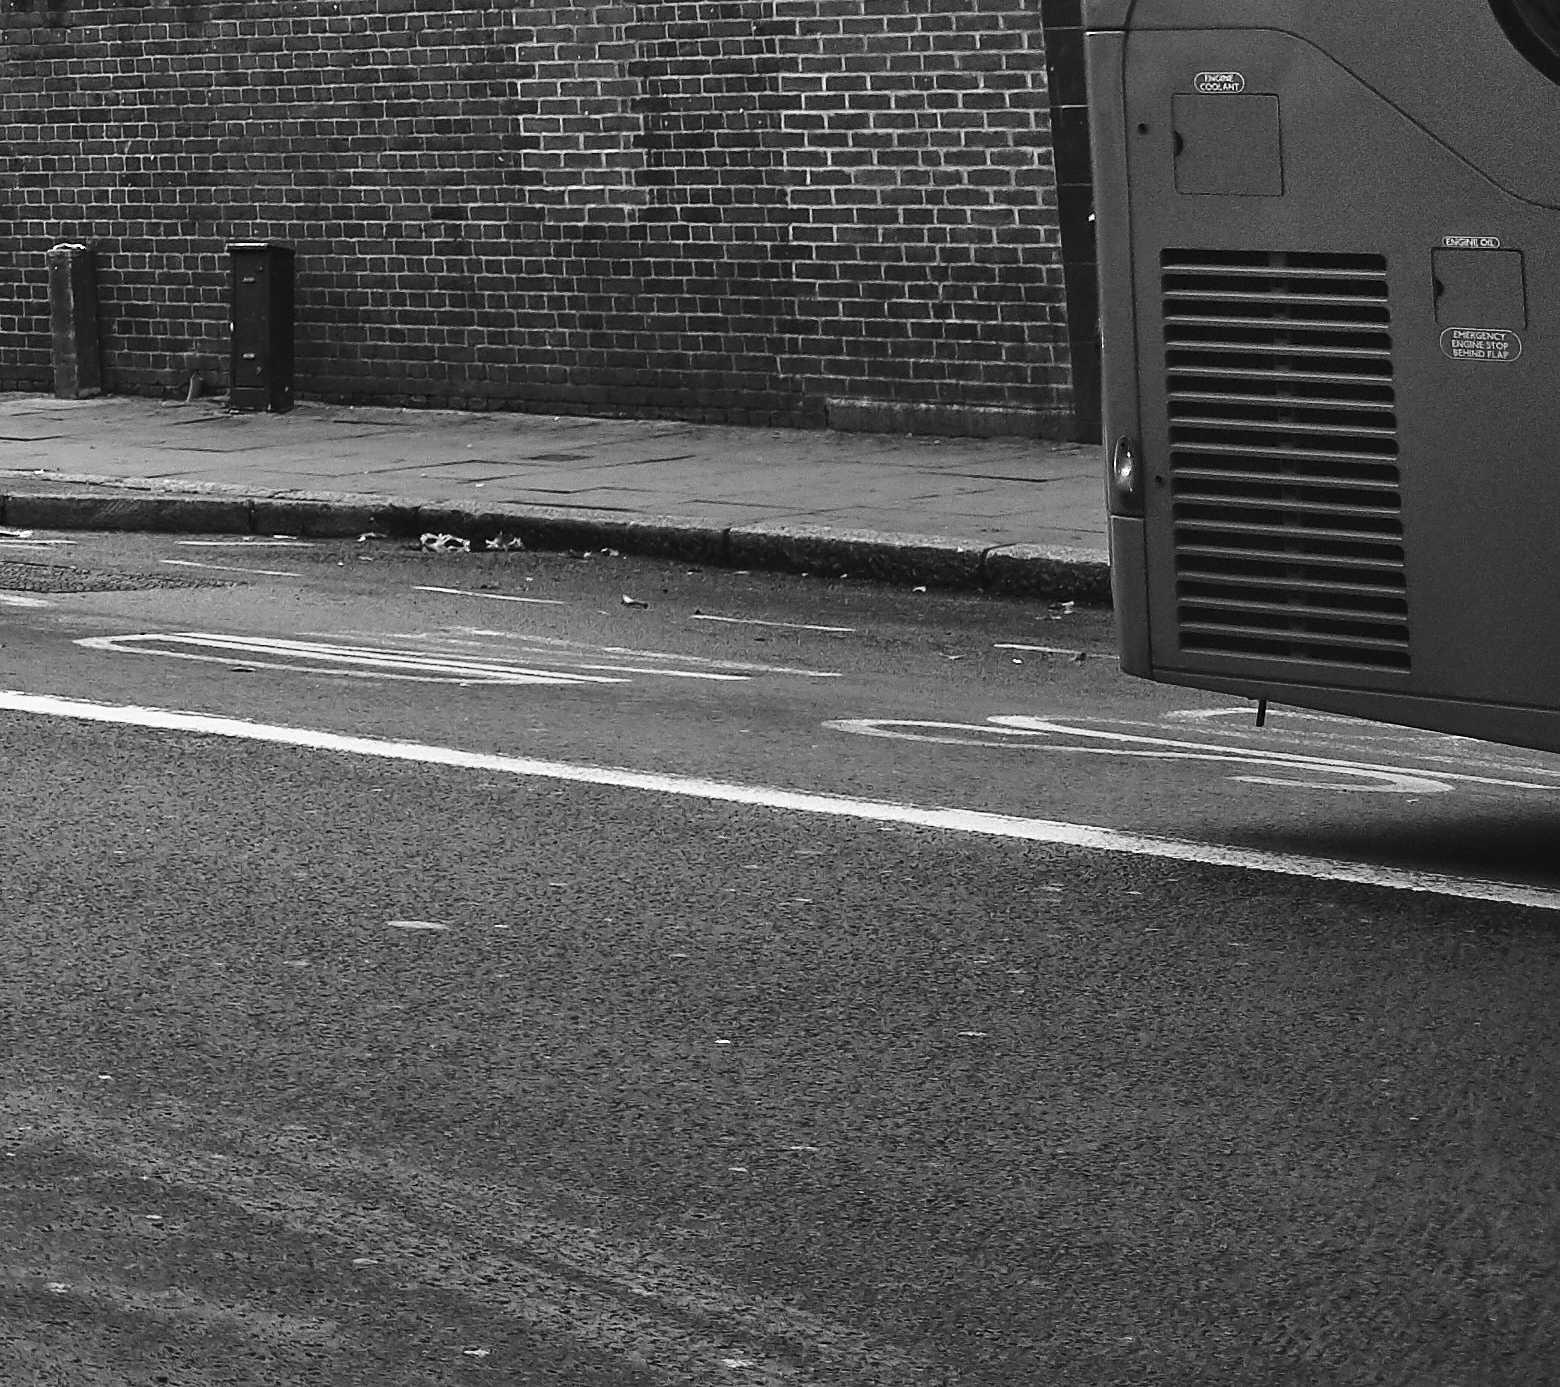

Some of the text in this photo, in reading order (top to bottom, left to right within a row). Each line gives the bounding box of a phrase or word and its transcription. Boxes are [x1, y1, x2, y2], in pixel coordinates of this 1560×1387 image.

[1200, 82, 1240, 91] COOLANT
[1445, 238, 1494, 247] ENGINE OIL
[1453, 330, 1507, 341] EMERGENCY
[1451, 339, 1509, 350] ENGINE STOP
[1452, 348, 1509, 359] BEHIND FLAP
